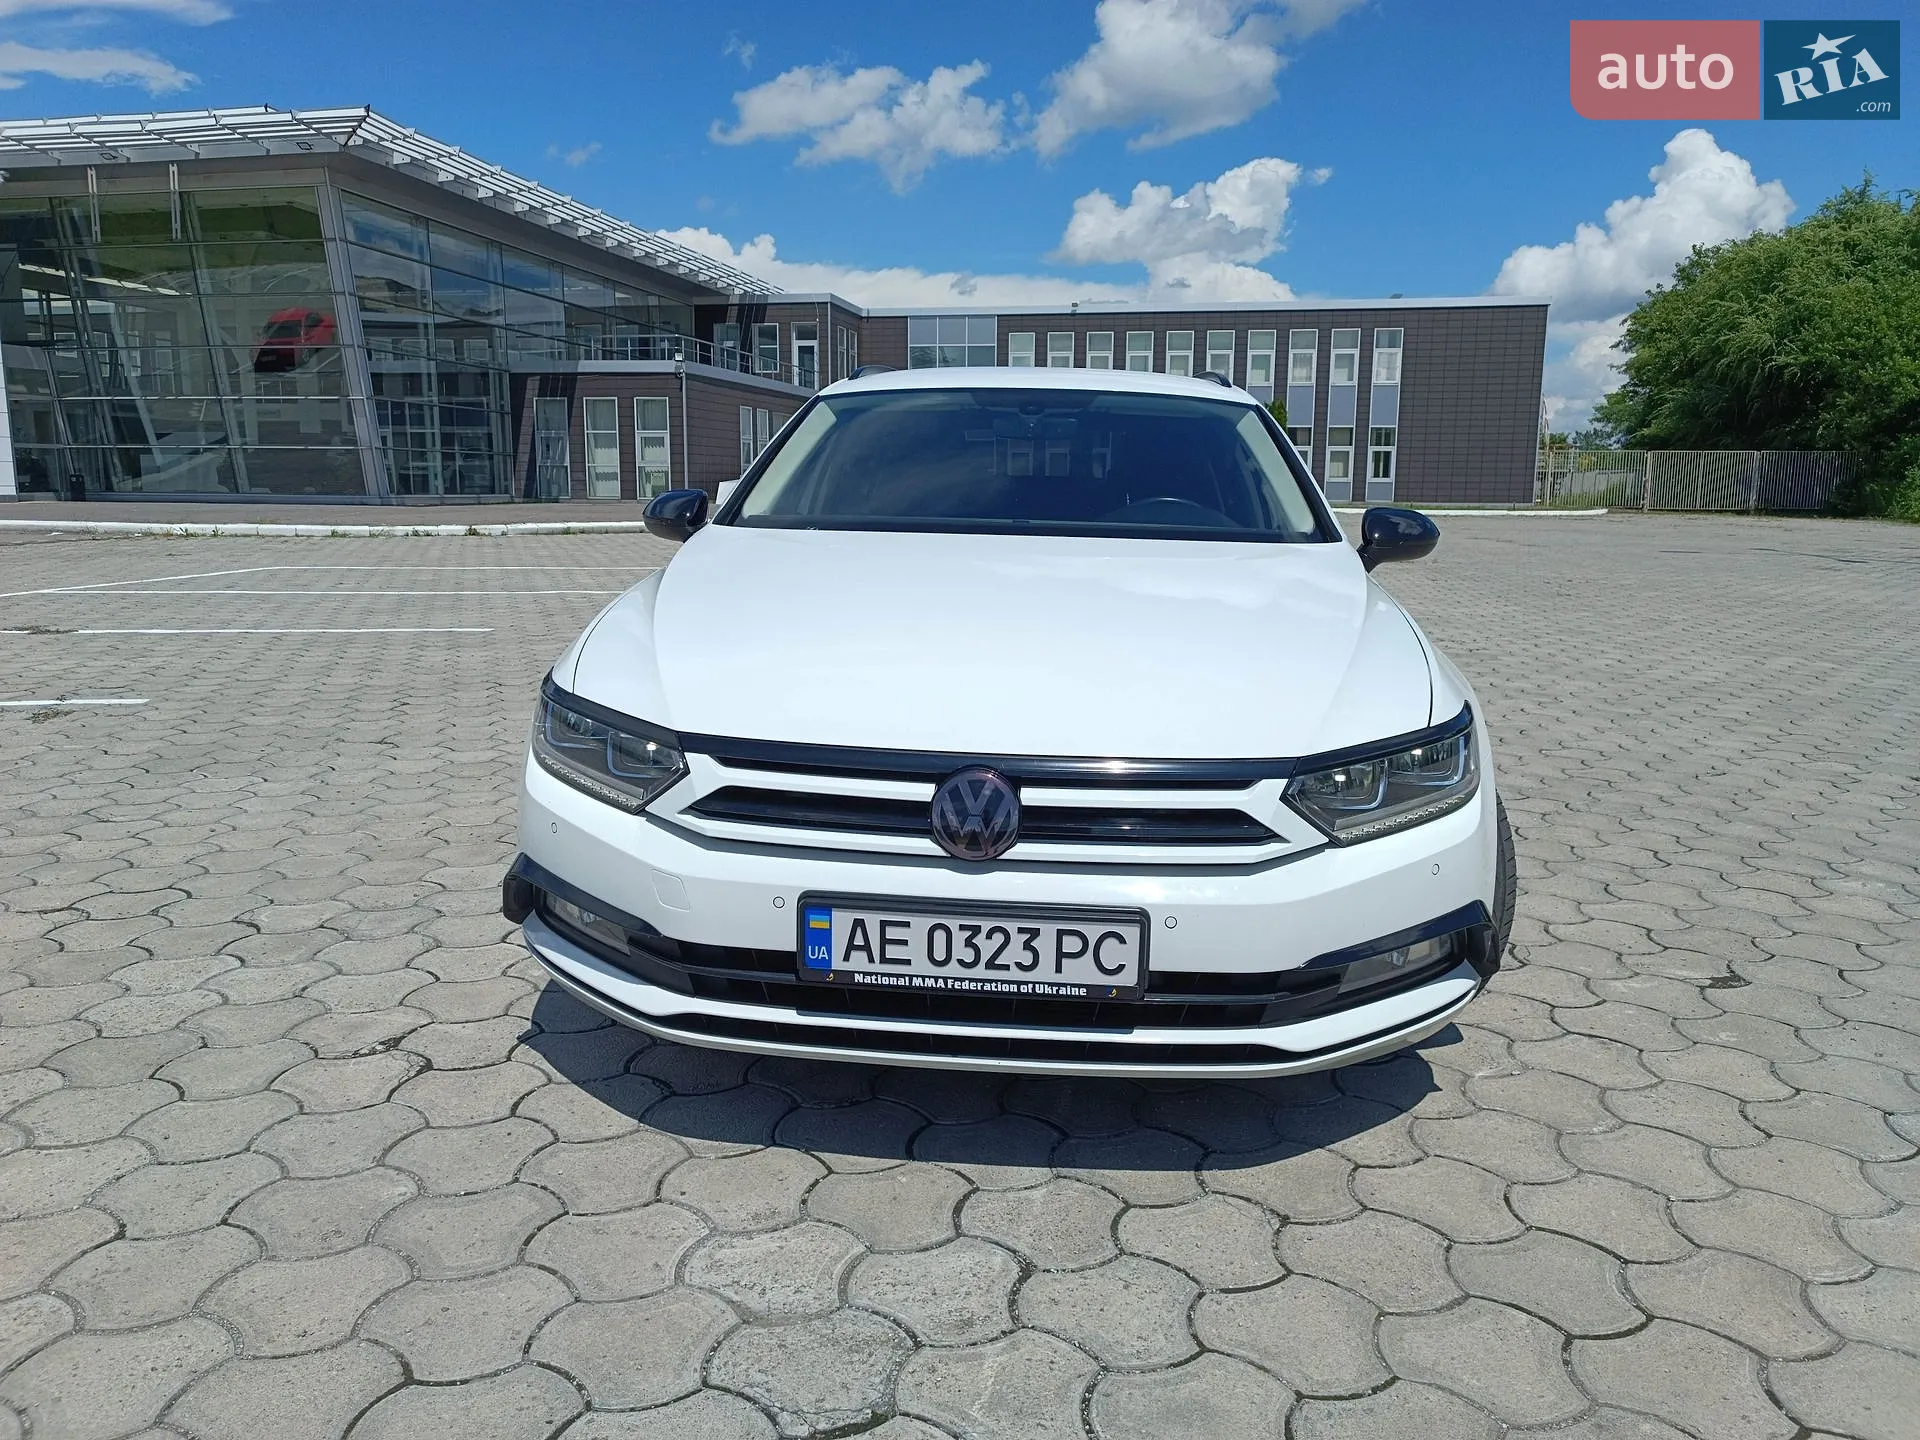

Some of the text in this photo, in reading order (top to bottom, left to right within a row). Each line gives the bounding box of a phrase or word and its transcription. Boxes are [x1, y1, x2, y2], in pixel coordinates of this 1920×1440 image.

[808, 945, 829, 961] UA
[842, 918, 1129, 976] AE 0323 PC
[854, 973, 1087, 996] National MMA Federation of Ukraine
